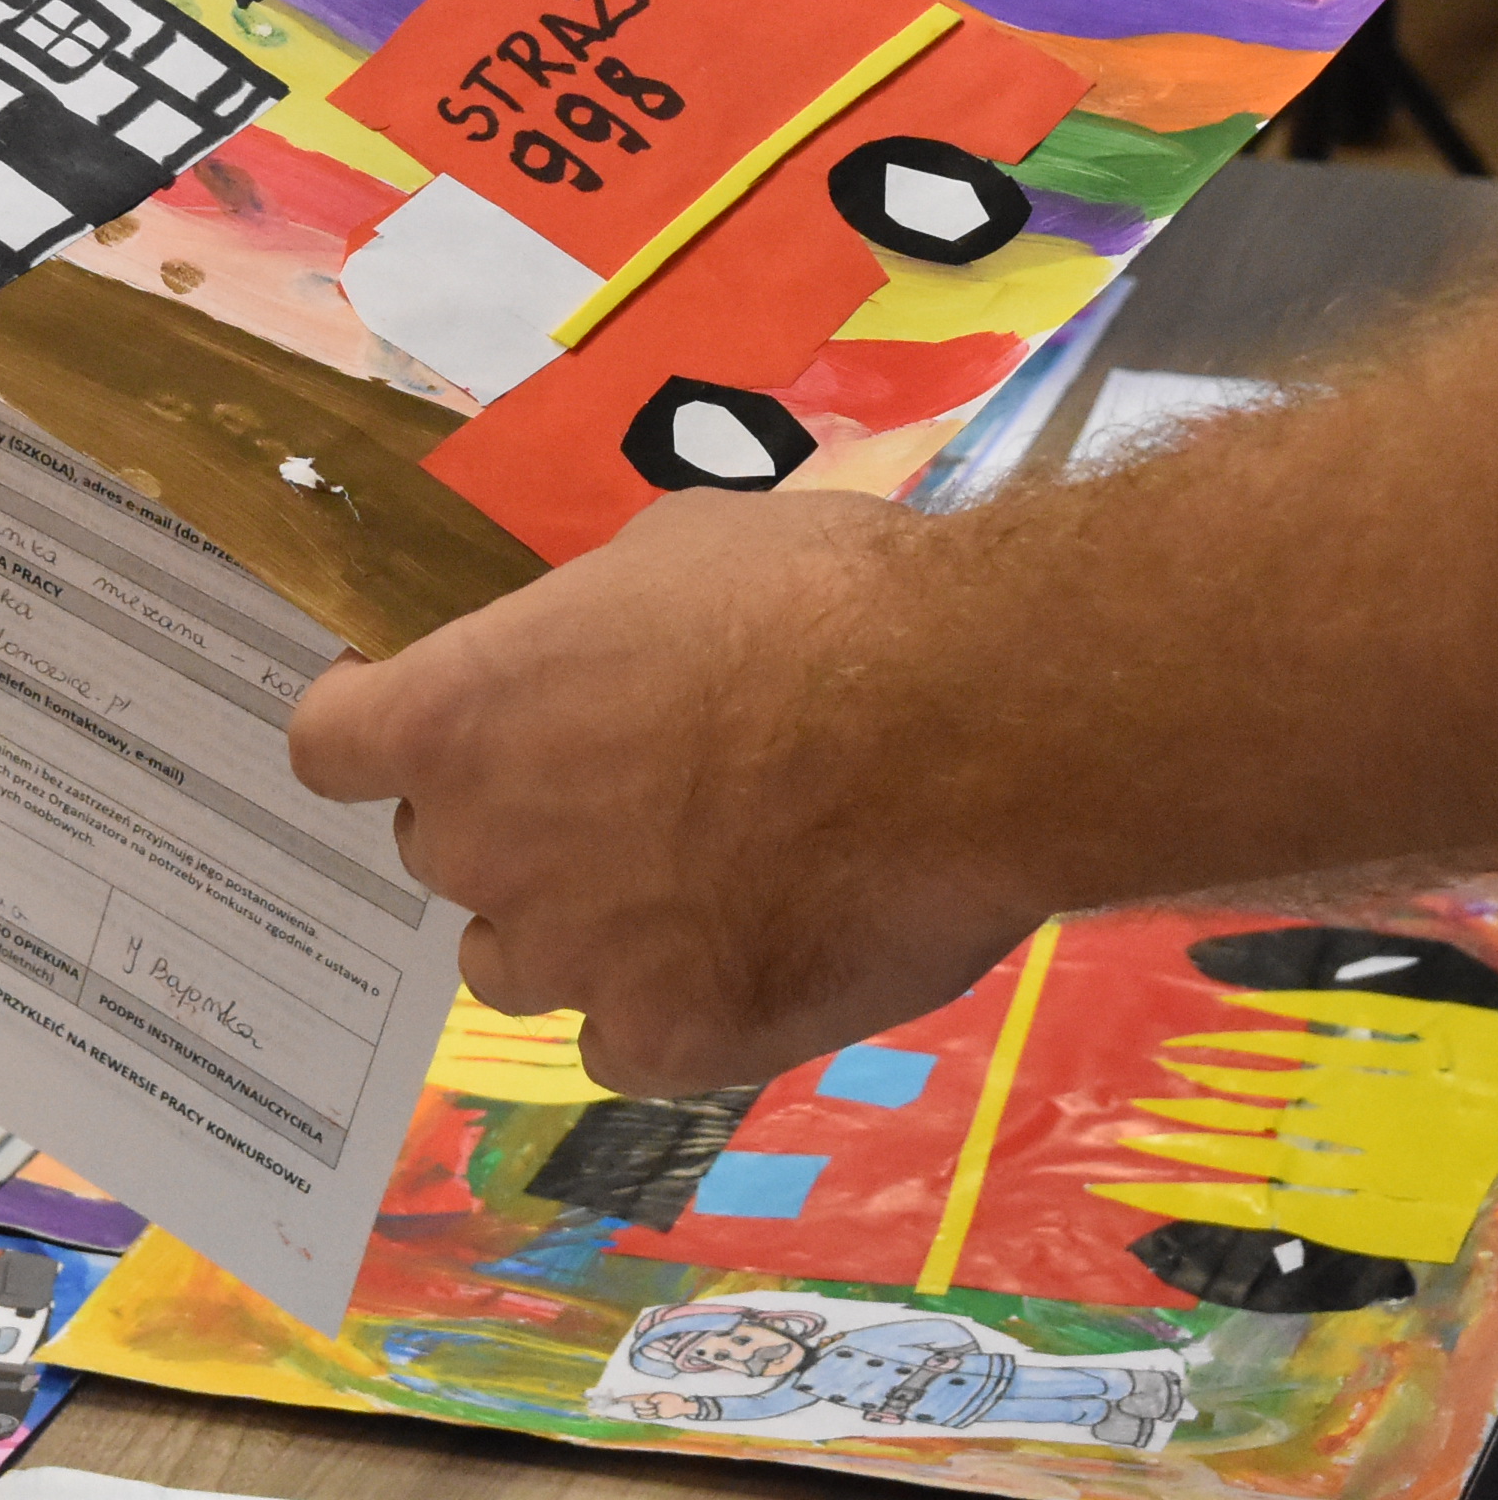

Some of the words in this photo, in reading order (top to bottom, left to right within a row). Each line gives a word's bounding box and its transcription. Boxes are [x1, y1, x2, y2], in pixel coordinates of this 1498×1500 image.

[509, 56, 686, 193] 998
[7, 434, 78, 484] (SZKOŁA),
[81, 476, 122, 505] adres
[124, 499, 173, 530] e-mail
[173, 521, 200, 544] (do
[10, 561, 63, 598] PRACY
[43, 694, 131, 756] kontaktowy,
[134, 749, 185, 786] e-mail)
[22, 799, 95, 847] osobowych.
[33, 765, 39, 775] i
[40, 767, 63, 789] bez
[63, 784, 131, 828] zastrzeżeń
[131, 822, 194, 867] przyjmuję
[193, 859, 224, 881] jego
[223, 877, 318, 940] postanowienia.
[11, 773, 46, 799] przez
[47, 792, 128, 846] Organizatora
[129, 840, 146, 856] na
[147, 851, 203, 891] potrzeby
[204, 882, 263, 926] konkursu
[263, 920, 314, 957] zgodnie
[314, 951, 322, 962] z
[323, 957, 369, 993] ustawą
[370, 986, 380, 997] o
[12, 934, 79, 981] OPIEKUNA
[65, 1030, 86, 1053] NA
[88, 1045, 158, 1097] REWERSIE
[158, 1089, 205, 1126] PRACY
[205, 1119, 311, 1194] KONKURSOWEJ
[97, 993, 145, 1030] PODPIS
[146, 1023, 323, 1144] INSTRUKTORA/NAUCZYCIELA
